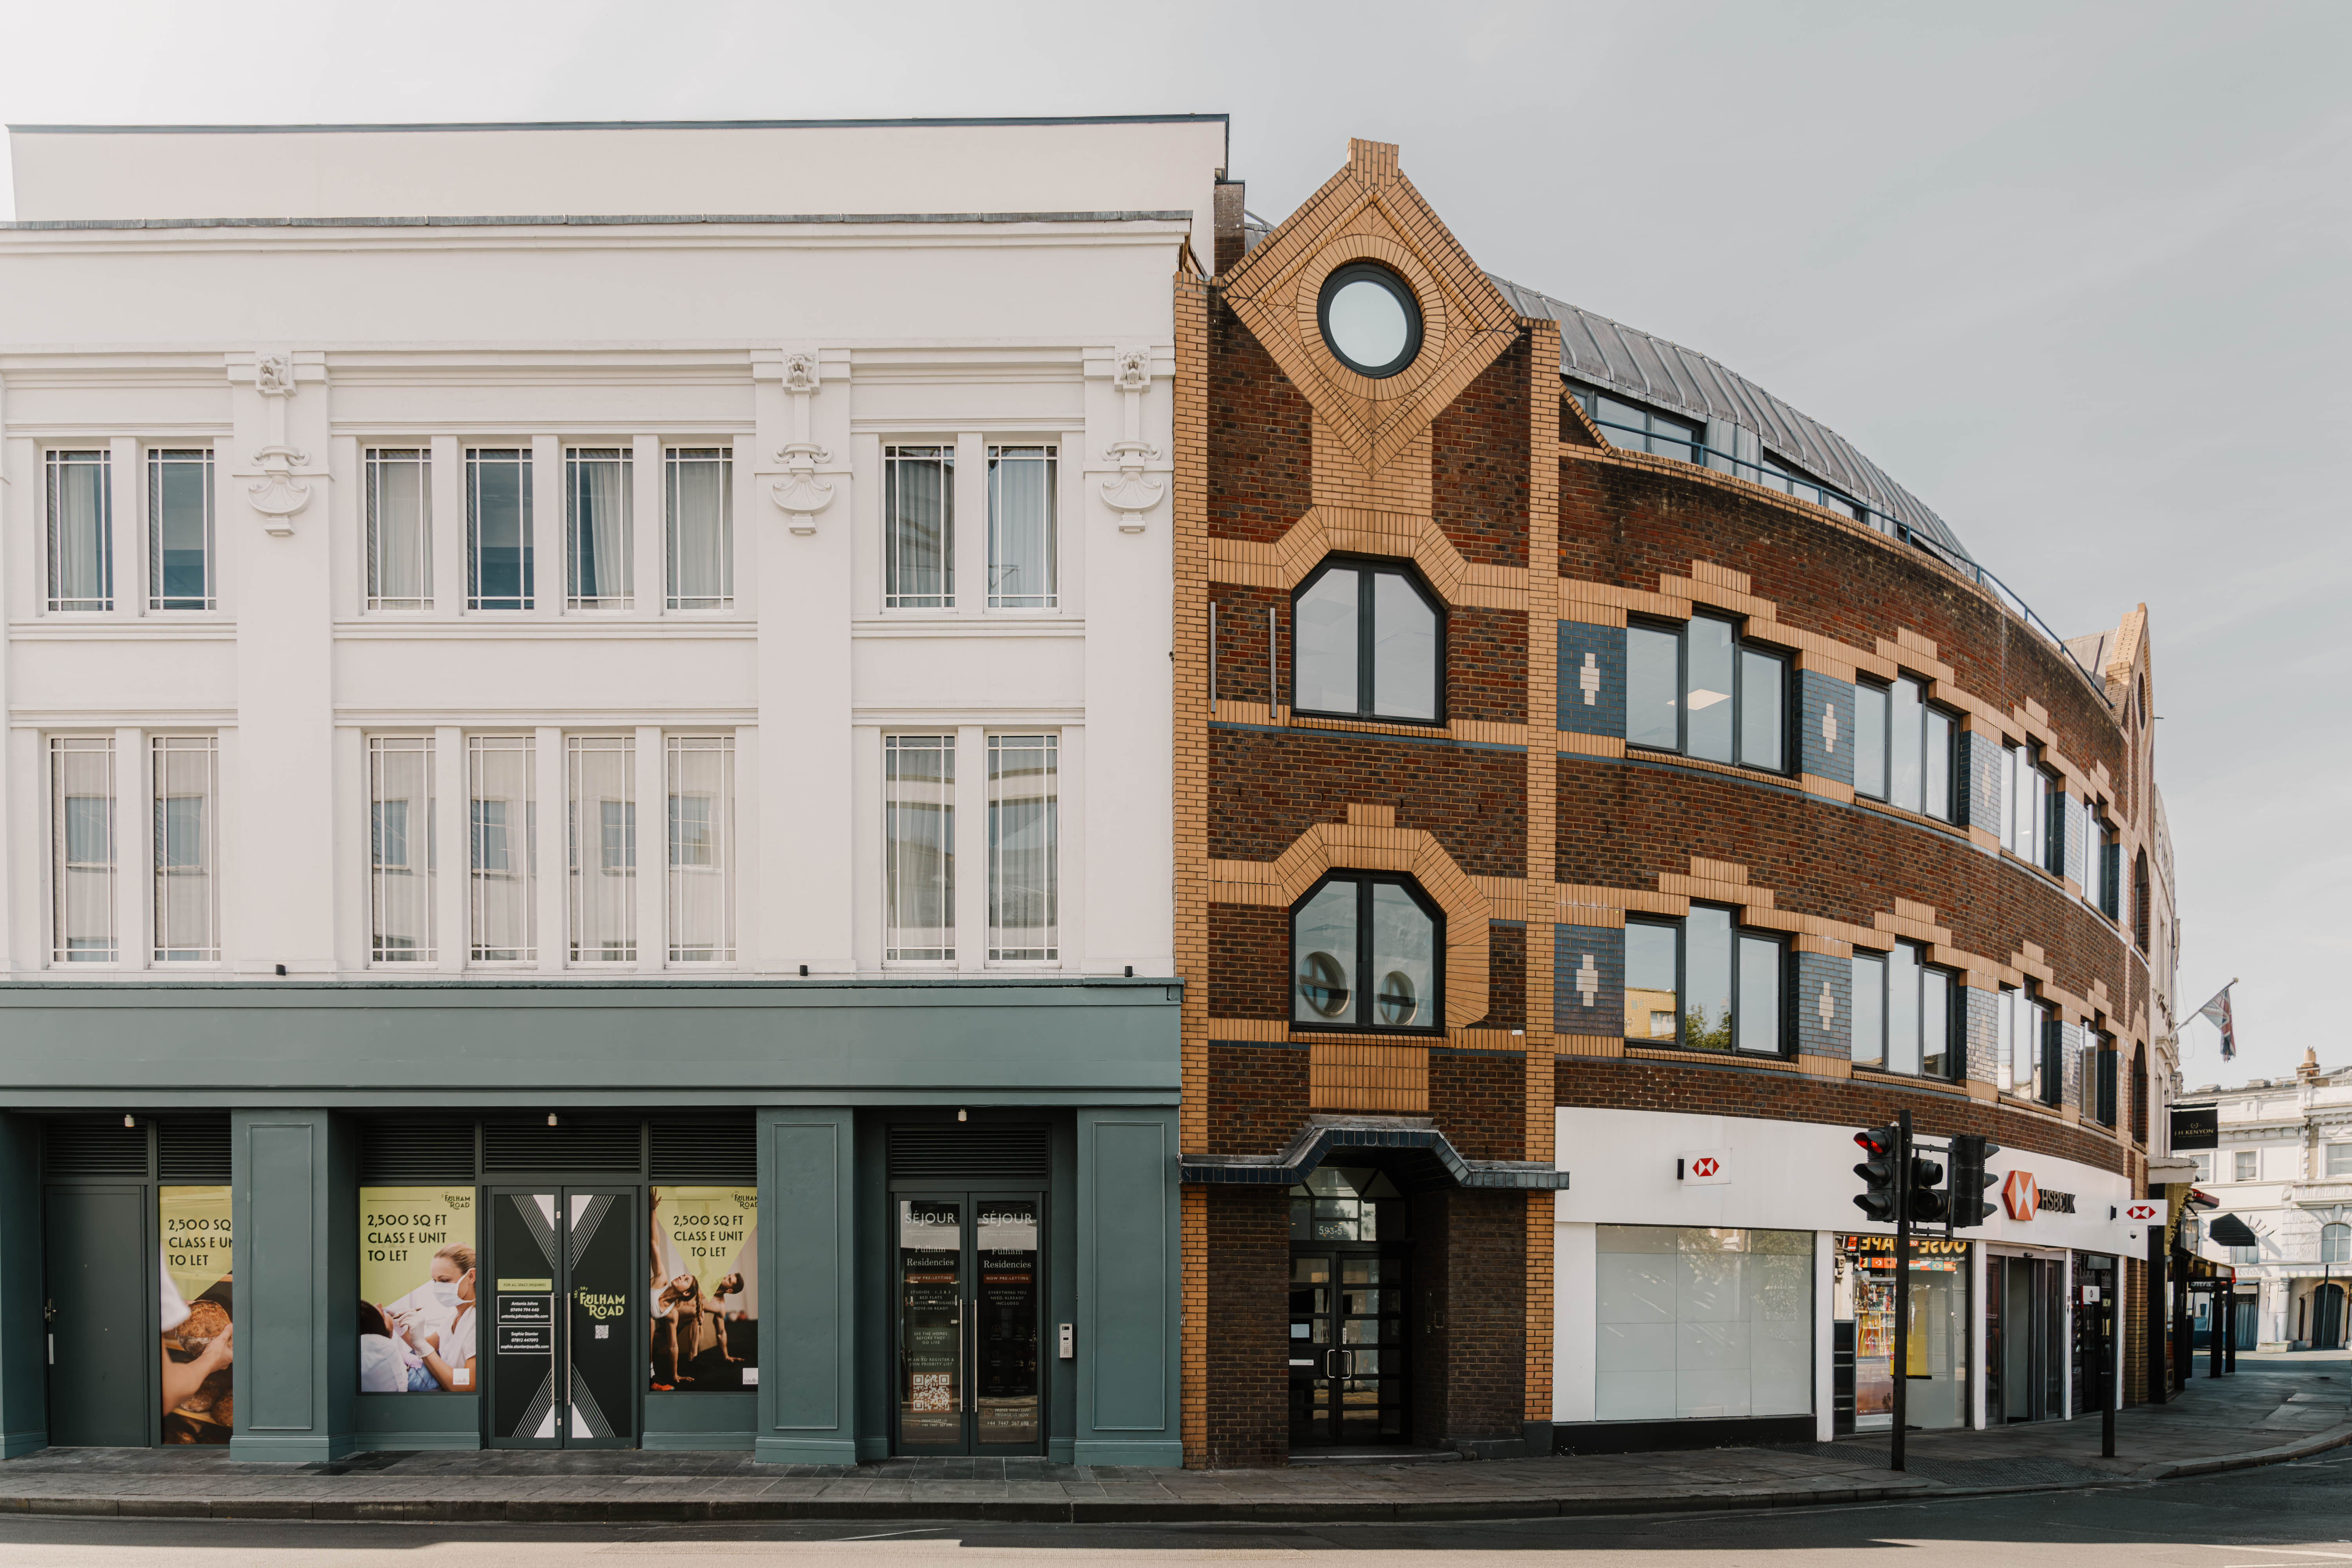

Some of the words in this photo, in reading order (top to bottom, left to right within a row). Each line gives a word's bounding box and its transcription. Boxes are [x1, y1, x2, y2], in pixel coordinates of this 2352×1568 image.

[445, 1194, 470, 1203] FULHAM
[2042, 1189, 2065, 1212] HSBC
[2066, 1193, 2076, 1214] UK
[450, 1201, 470, 1210] ROAD
[367, 1214, 409, 1227] 2,500
[413, 1214, 430, 1227] SQ
[435, 1214, 447, 1225] FT
[673, 1215, 710, 1227] 2,500
[713, 1215, 729, 1226] SQ
[733, 1215, 744, 1225] FT
[905, 1210, 956, 1226] SÉJOUR
[982, 1210, 1033, 1227] SÉJOUR
[168, 1219, 209, 1232] 2,500
[213, 1219, 231, 1231] SQ
[1319, 1225, 1348, 1236] 593-59
[368, 1232, 405, 1243] CLASS
[409, 1232, 414, 1243] E
[419, 1232, 446, 1243] UNIT
[674, 1231, 707, 1241] CLASS
[710, 1231, 715, 1241] E
[719, 1231, 744, 1241] UNIT
[169, 1237, 206, 1248] CLASS
[210, 1237, 215, 1248] E
[219, 1237, 232, 1248] UN
[691, 1247, 706, 1257] TO
[710, 1247, 726, 1257] LET
[914, 1245, 946, 1253] Fulham
[991, 1246, 1023, 1255] Fulham
[169, 1254, 186, 1266] TO
[191, 1254, 209, 1266] LET
[368, 1250, 385, 1261] TO
[390, 1250, 408, 1261] LET
[906, 1258, 955, 1266] Residencies
[983, 1260, 1032, 1268] Residencies
[580, 1292, 625, 1307] FULHAM
[589, 1304, 624, 1320] ROAD
